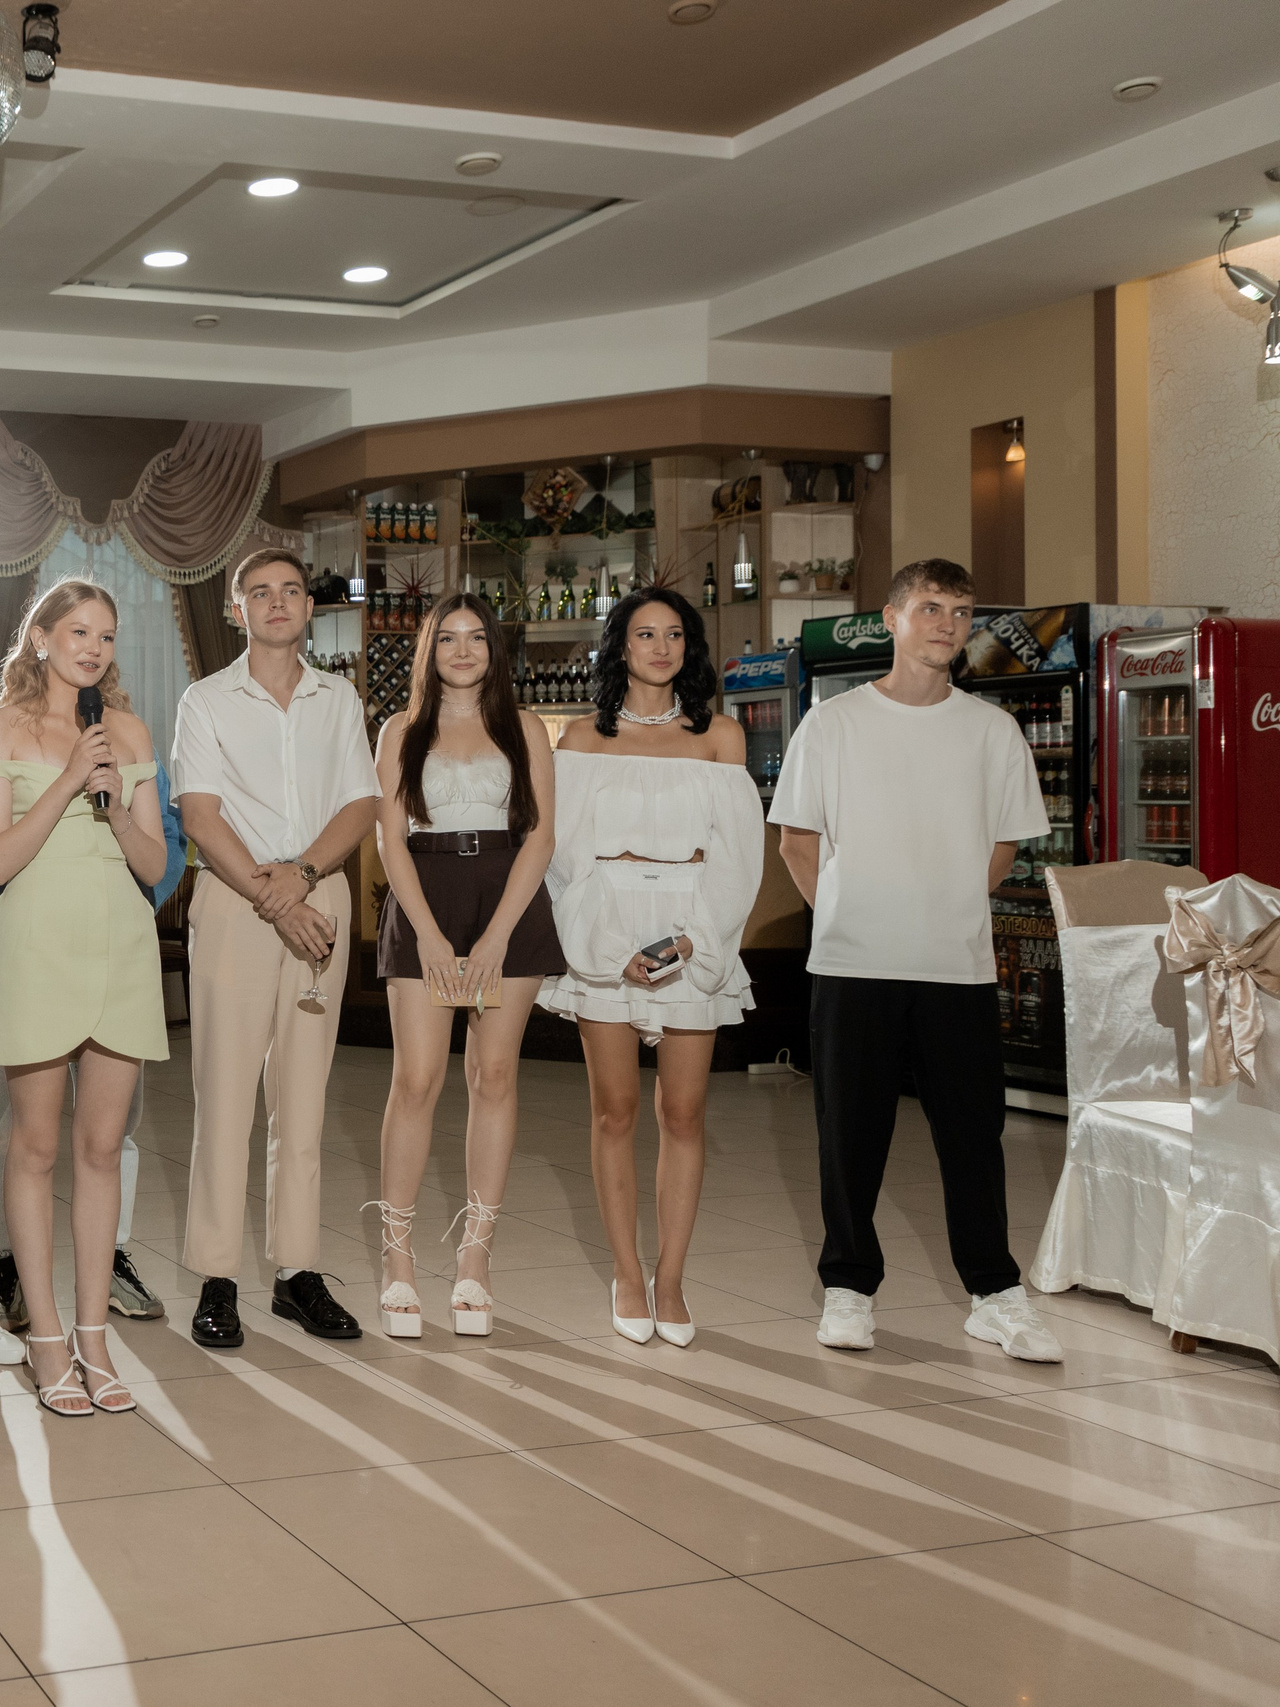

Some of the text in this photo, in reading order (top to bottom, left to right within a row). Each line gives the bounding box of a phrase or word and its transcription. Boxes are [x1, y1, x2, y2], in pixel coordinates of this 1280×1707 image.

[832, 616, 893, 648] Carlsber
[988, 614, 1041, 672] БОЧКА
[736, 658, 786, 679] PEPS
[1121, 649, 1187, 679] Coca-Cola
